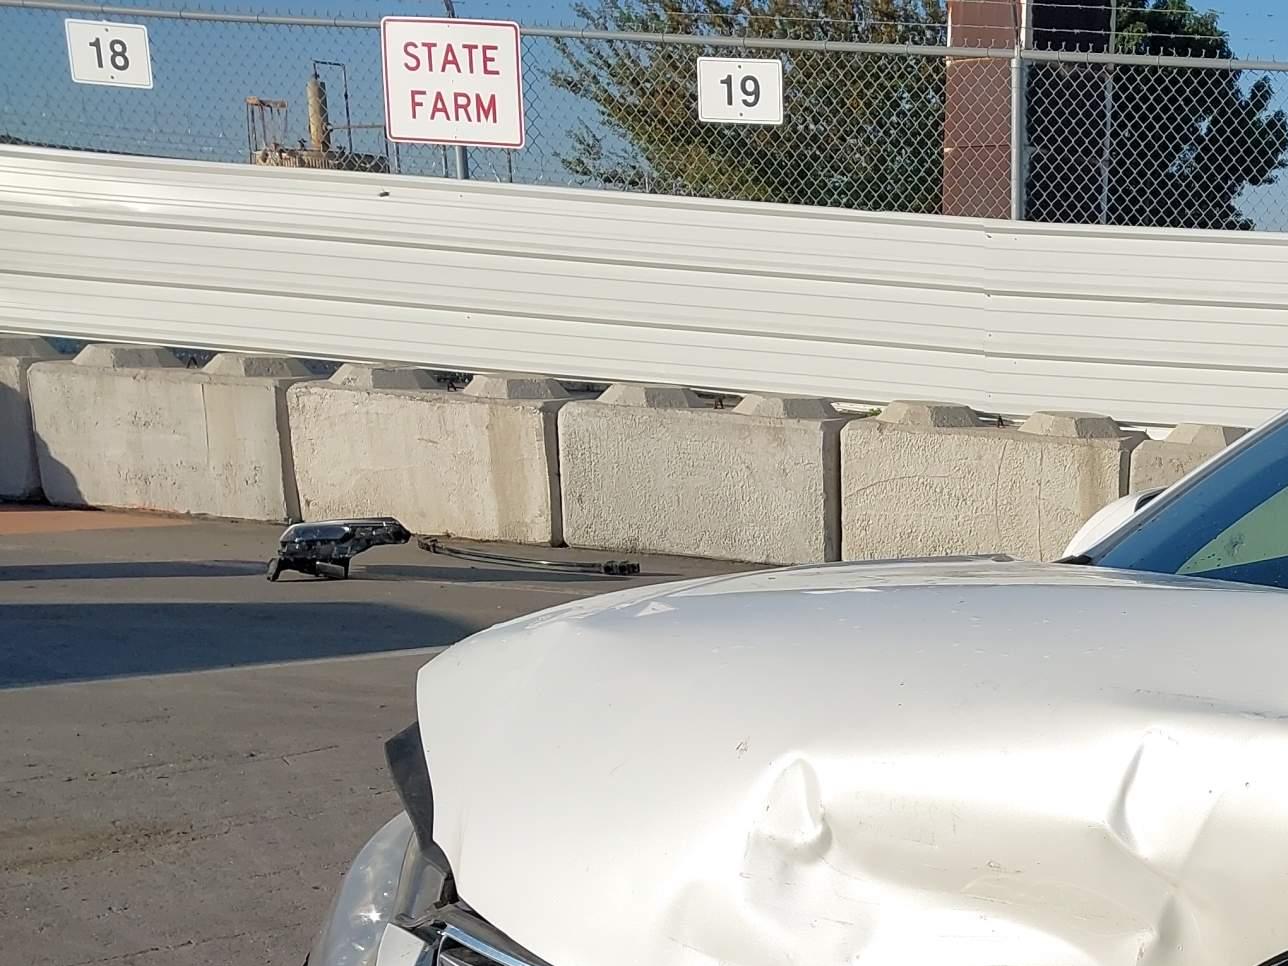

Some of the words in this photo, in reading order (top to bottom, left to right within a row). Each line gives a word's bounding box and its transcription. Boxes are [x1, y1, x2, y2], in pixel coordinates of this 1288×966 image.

[88, 38, 130, 71] 18
[402, 42, 501, 76] STATE
[410, 89, 499, 125] FARM
[719, 74, 761, 108] 19
